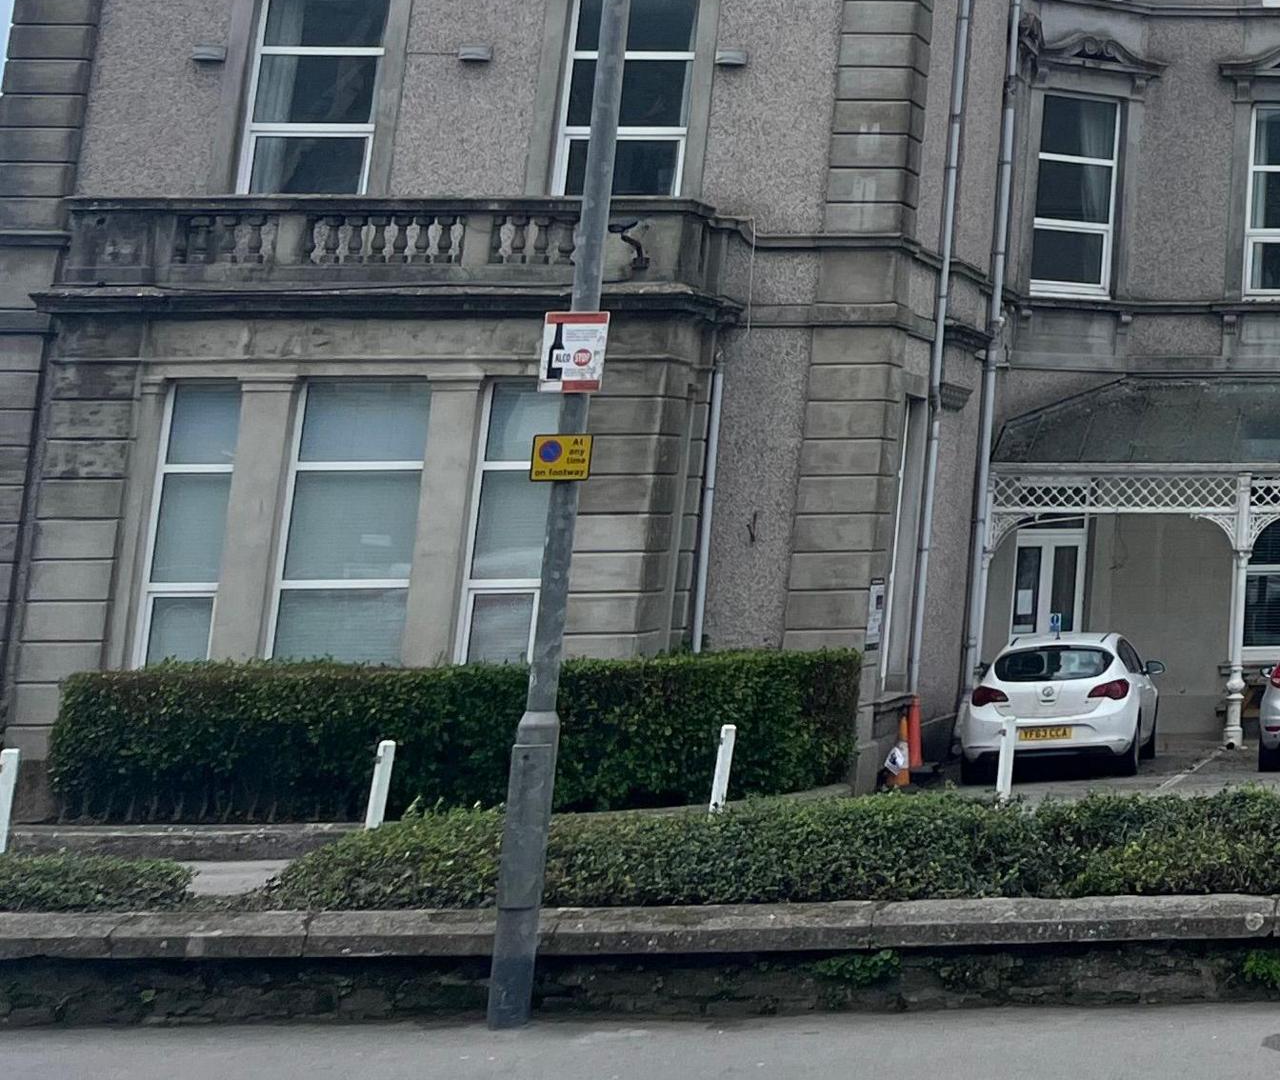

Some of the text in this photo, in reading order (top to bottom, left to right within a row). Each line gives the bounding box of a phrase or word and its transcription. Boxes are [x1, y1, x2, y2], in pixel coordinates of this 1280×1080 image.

[555, 352, 592, 363] ALCO STOP
[573, 438, 584, 446] At
[569, 449, 585, 457] any
[567, 456, 586, 465] time
[549, 468, 585, 477] footway
